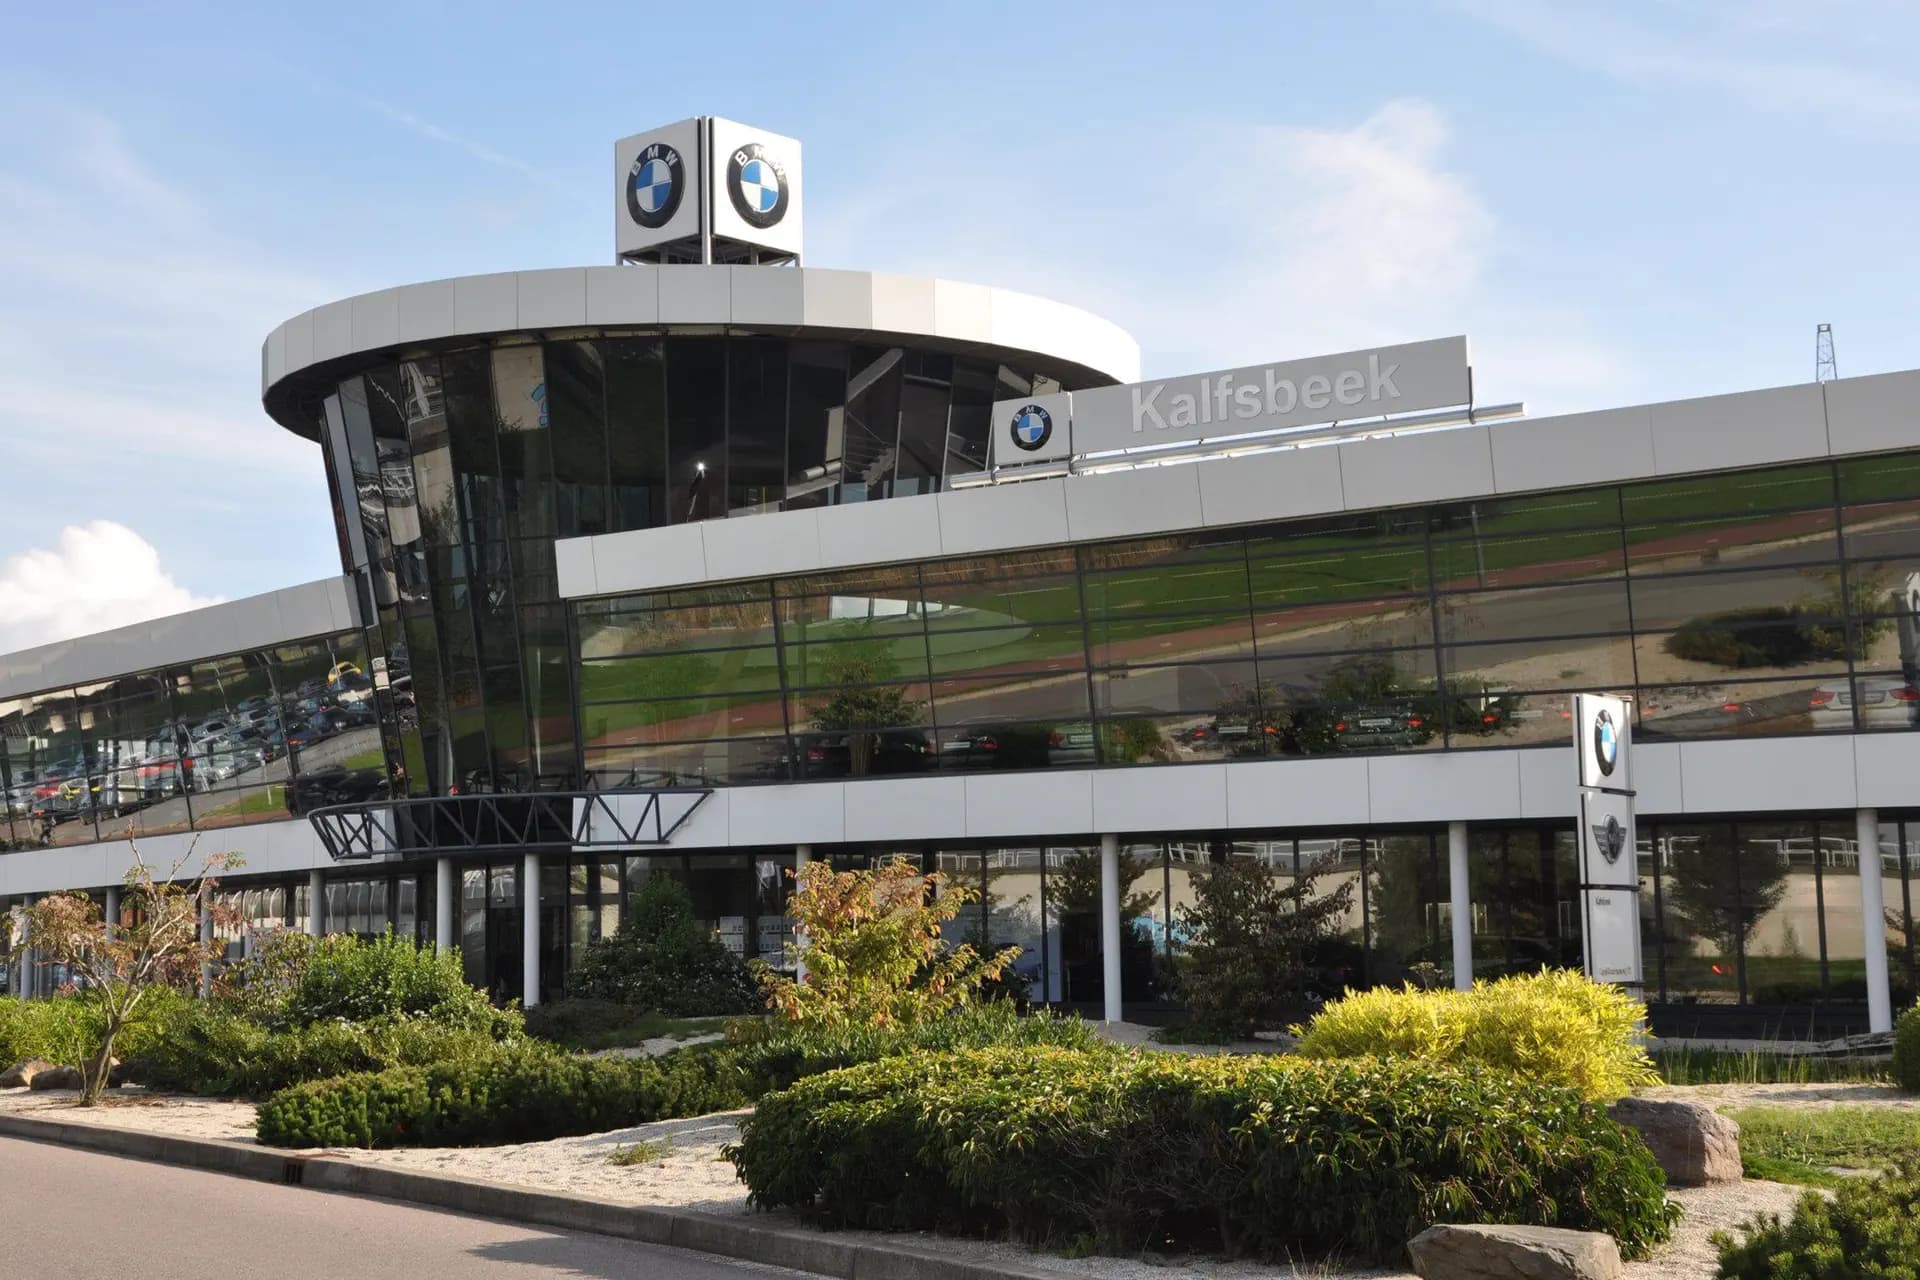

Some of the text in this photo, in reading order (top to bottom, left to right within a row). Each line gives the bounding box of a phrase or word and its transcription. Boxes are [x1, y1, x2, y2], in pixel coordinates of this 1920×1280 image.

[631, 145, 678, 176] BMW
[1131, 354, 1401, 432] Kalfsbeek
[1014, 406, 1048, 422] BMW
